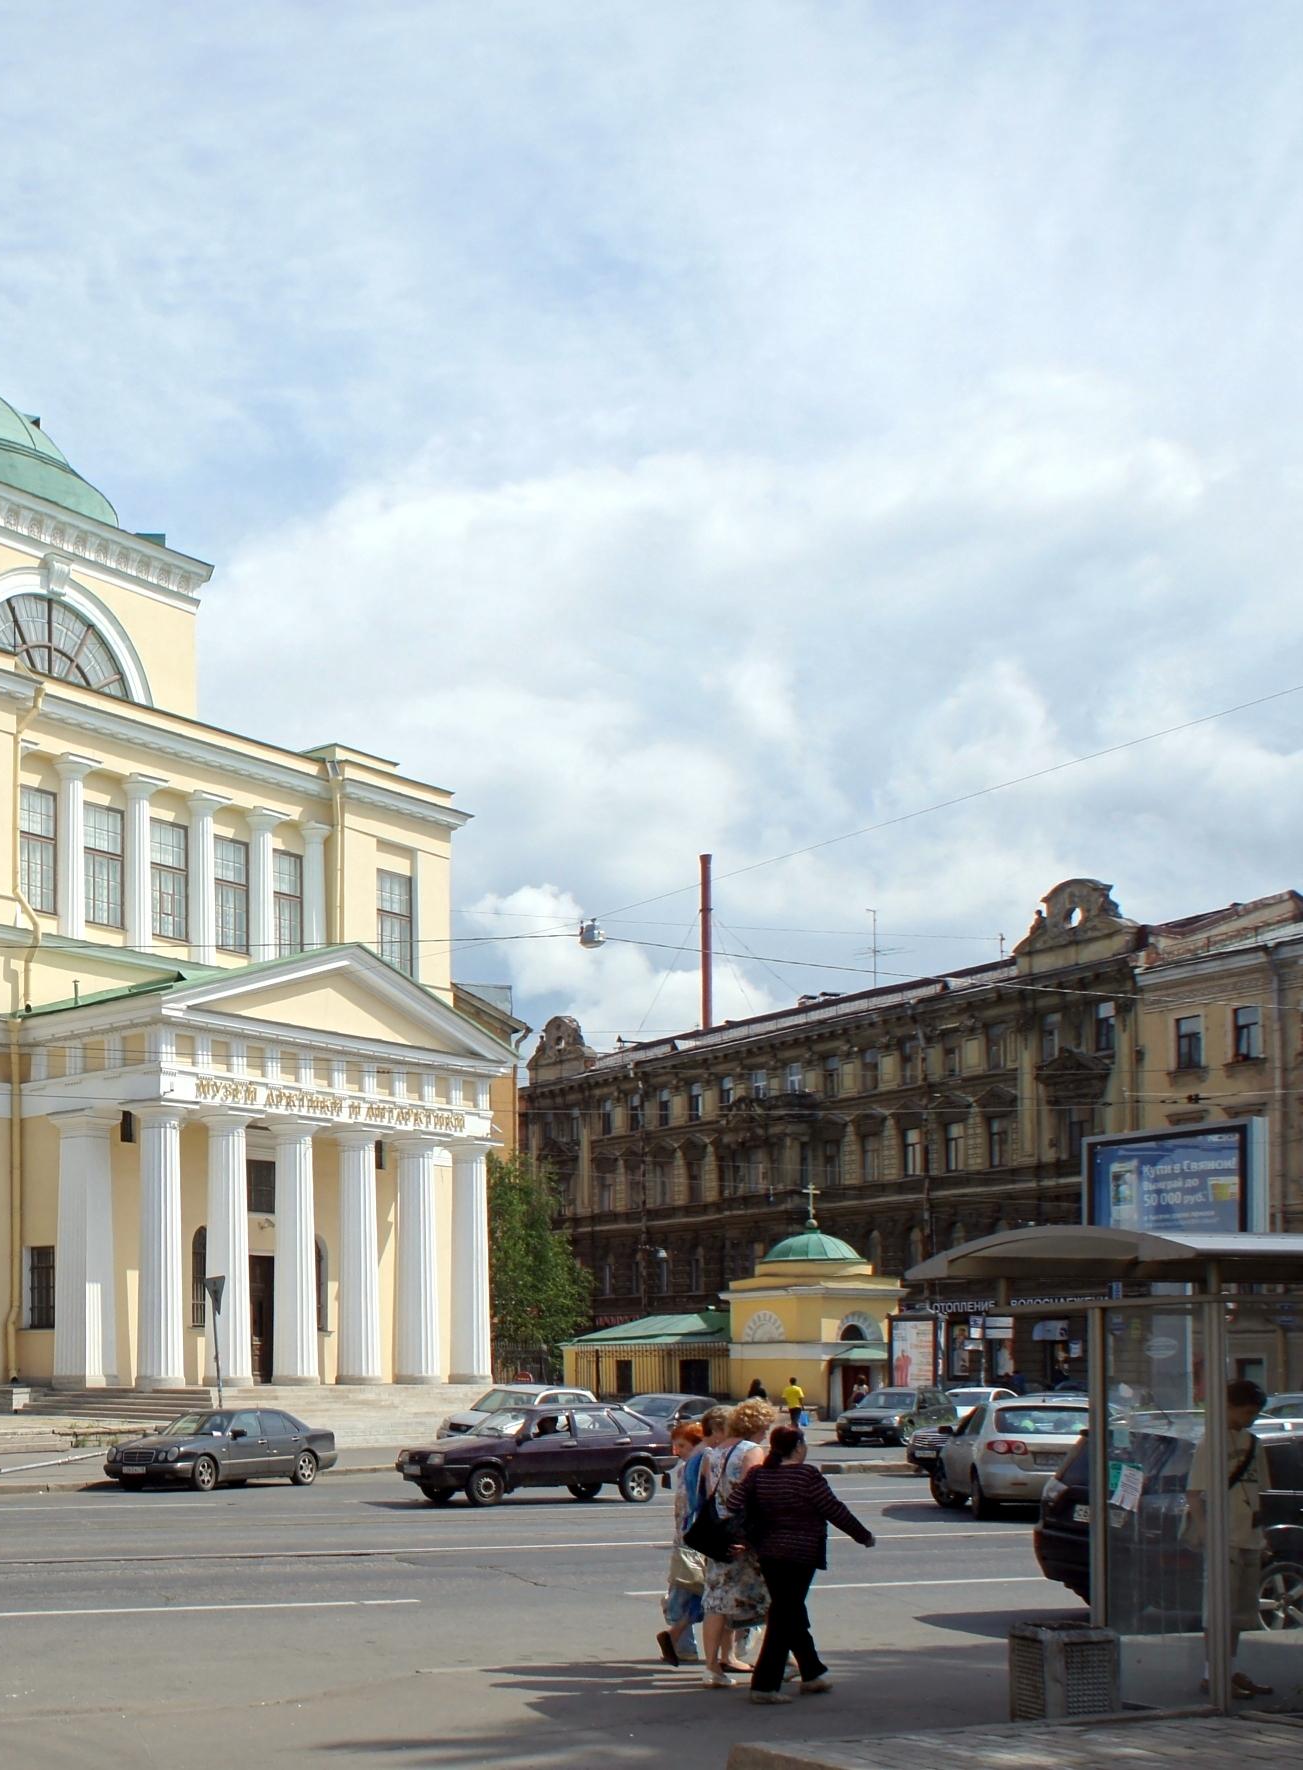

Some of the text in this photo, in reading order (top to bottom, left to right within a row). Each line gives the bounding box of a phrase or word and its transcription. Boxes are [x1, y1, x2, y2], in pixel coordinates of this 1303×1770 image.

[195, 1079, 257, 1105] МУЗЕЙ
[264, 1087, 343, 1117] АРКТИКИ
[365, 1103, 465, 1132] АНТАРКТИКИ
[932, 1301, 995, 1313] ОТОПЛЕНИЕ
